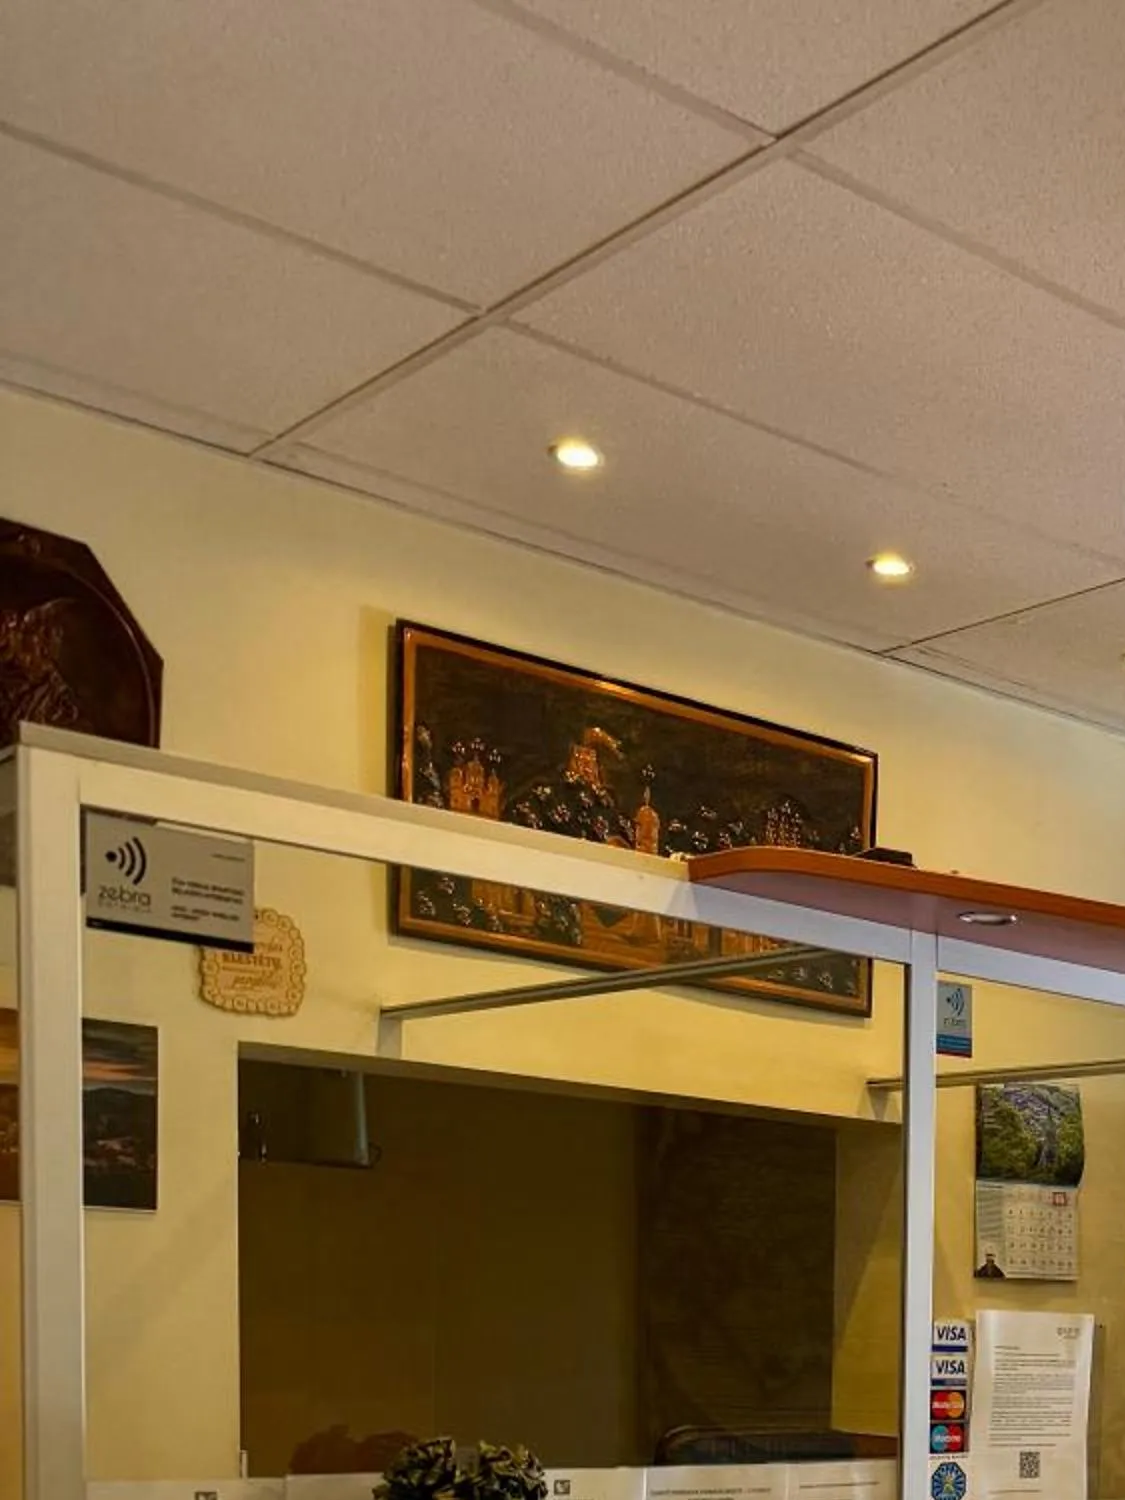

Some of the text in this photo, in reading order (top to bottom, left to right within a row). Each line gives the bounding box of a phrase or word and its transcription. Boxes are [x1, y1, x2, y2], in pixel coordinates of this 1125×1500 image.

[98, 884, 152, 907] zebra
[936, 1325, 967, 1342] VISA
[935, 1360, 965, 1374] VISA
